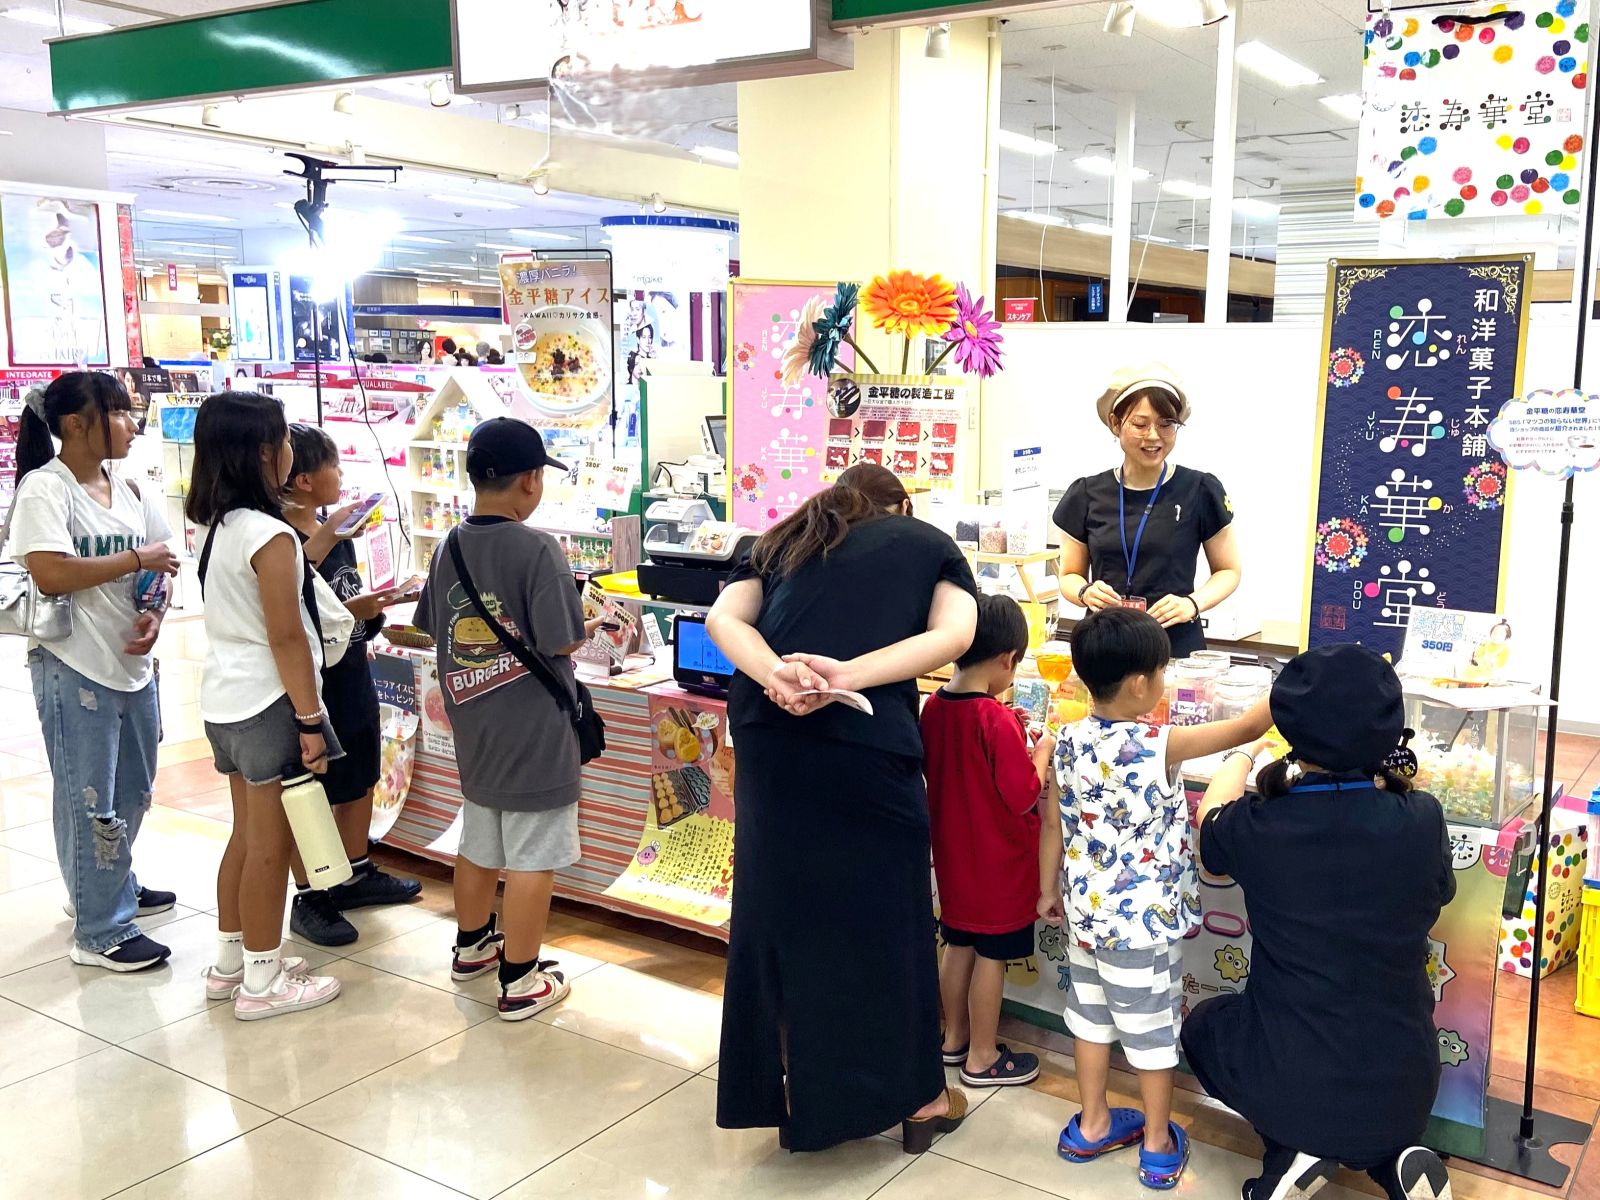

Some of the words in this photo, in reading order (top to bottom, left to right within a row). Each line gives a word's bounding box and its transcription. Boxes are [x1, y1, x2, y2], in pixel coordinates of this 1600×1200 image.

[508, 287, 610, 306] 金平糖アイス
[1371, 329, 1383, 360] REN
[1454, 334, 1468, 355] れん
[1461, 288, 1499, 457] 和洋菓子本舗
[359, 380, 393, 390] QUALABEL
[867, 386, 955, 401] 金平糖の製造工程
[1365, 411, 1377, 441] JYU
[1359, 494, 1370, 515] KA
[1352, 580, 1363, 610] DOU
[1421, 640, 1453, 652] 350円
